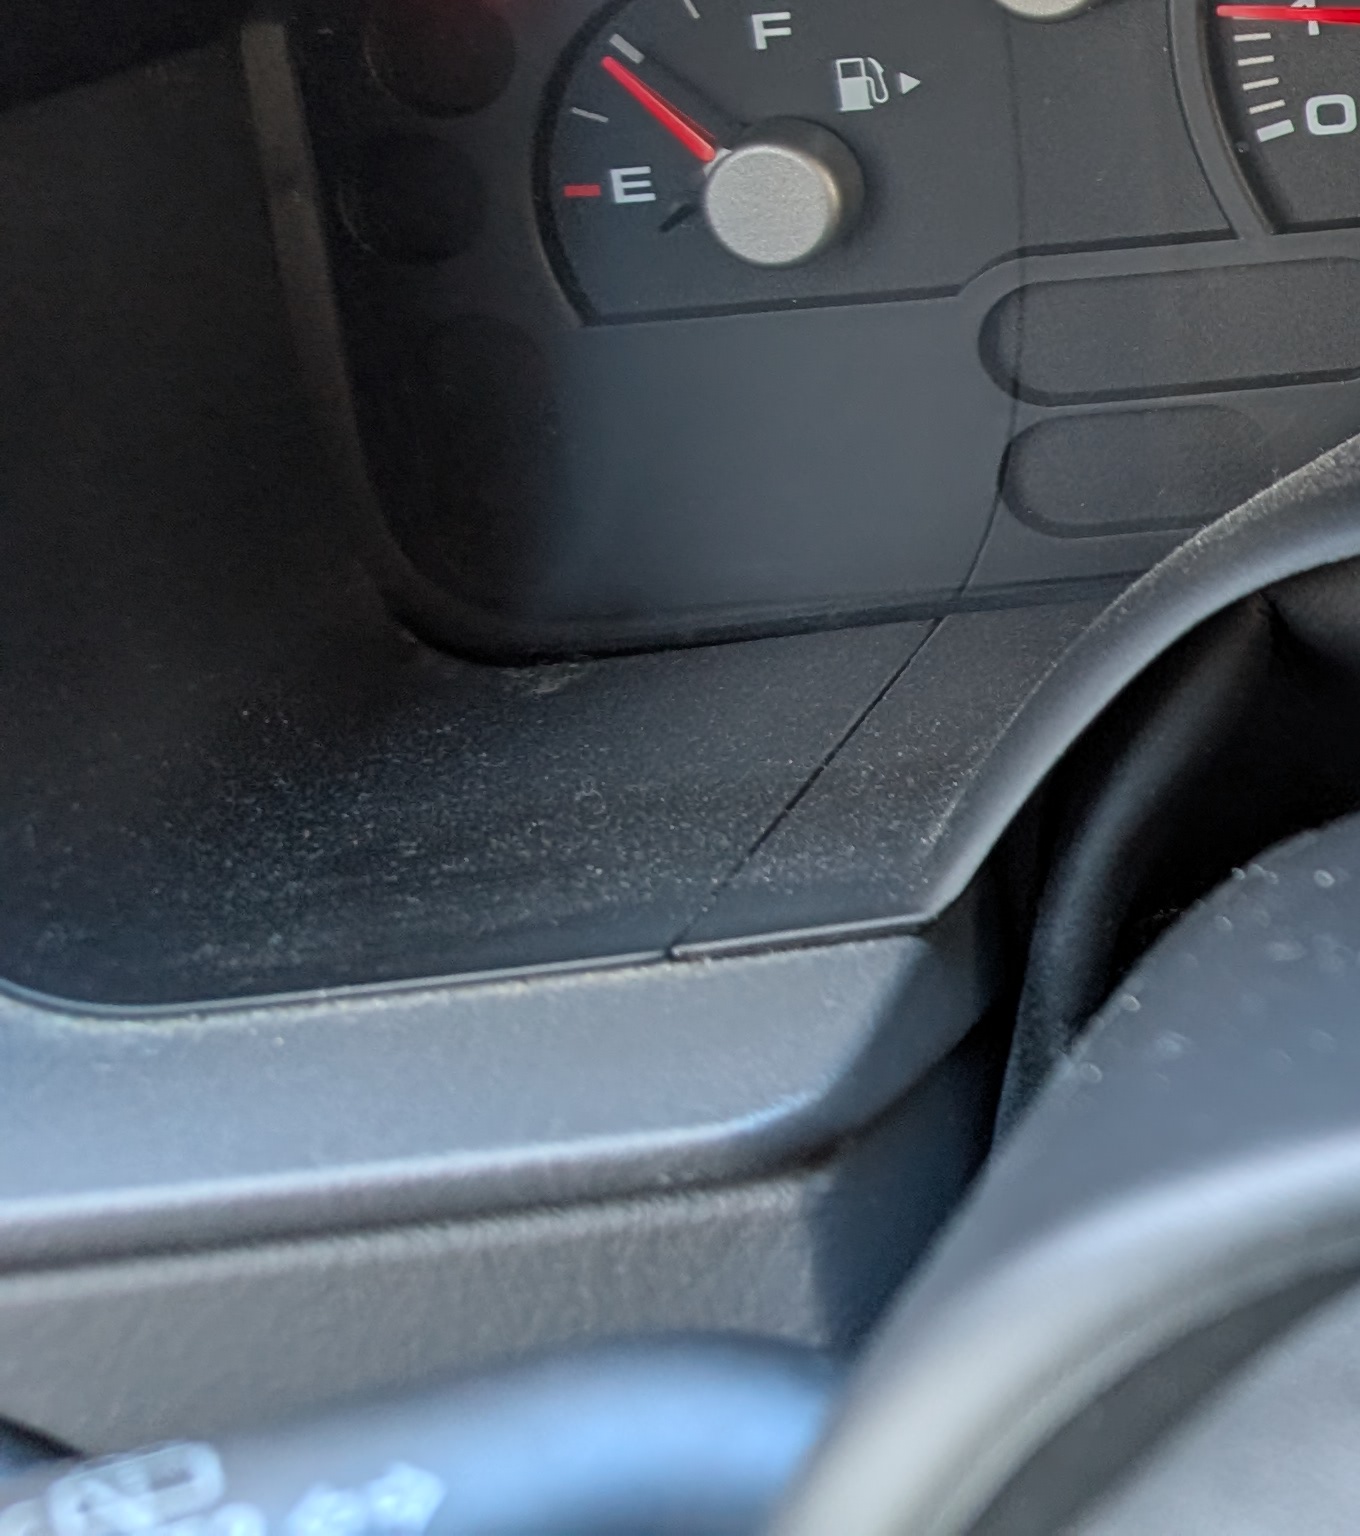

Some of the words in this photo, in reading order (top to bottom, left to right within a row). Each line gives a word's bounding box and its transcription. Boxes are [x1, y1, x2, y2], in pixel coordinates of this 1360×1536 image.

[751, 11, 792, 50] F
[1304, 93, 1357, 136] 0
[609, 166, 656, 204] E
